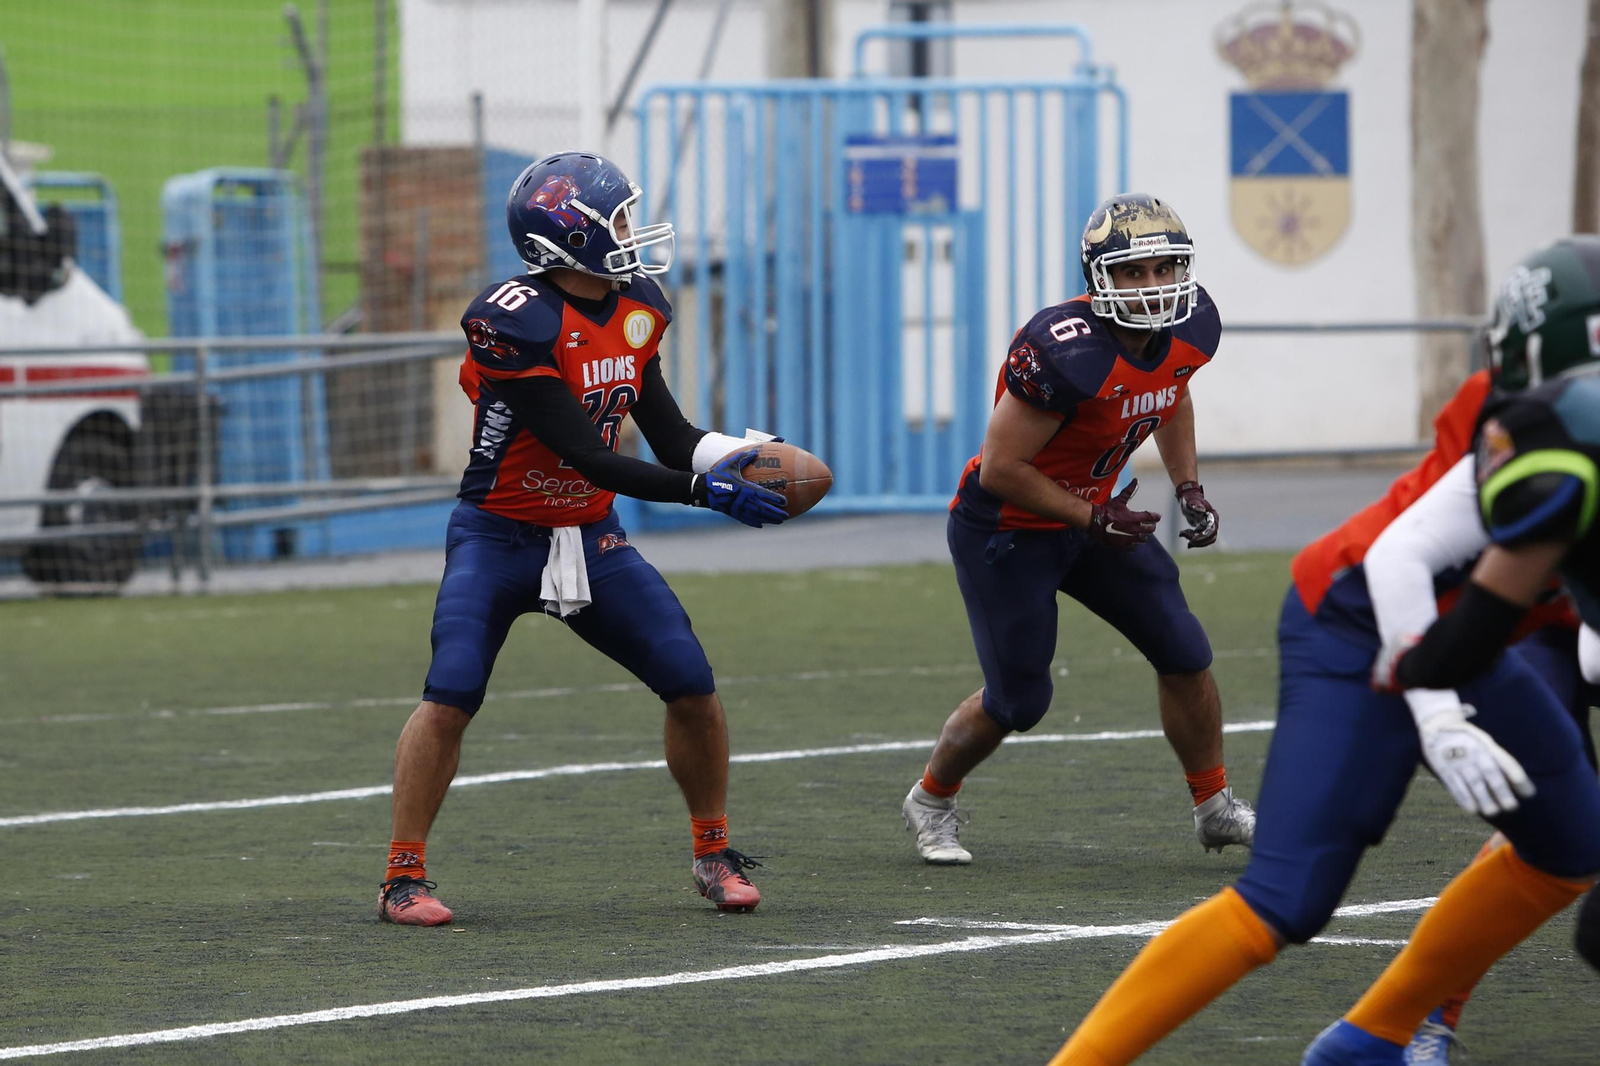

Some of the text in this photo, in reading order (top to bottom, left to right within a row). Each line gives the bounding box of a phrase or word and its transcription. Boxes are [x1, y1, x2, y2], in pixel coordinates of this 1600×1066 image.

[485, 280, 539, 312] 16
[1049, 317, 1092, 342] 6
[582, 355, 636, 388] LIONS
[1120, 385, 1178, 419] LIONS
